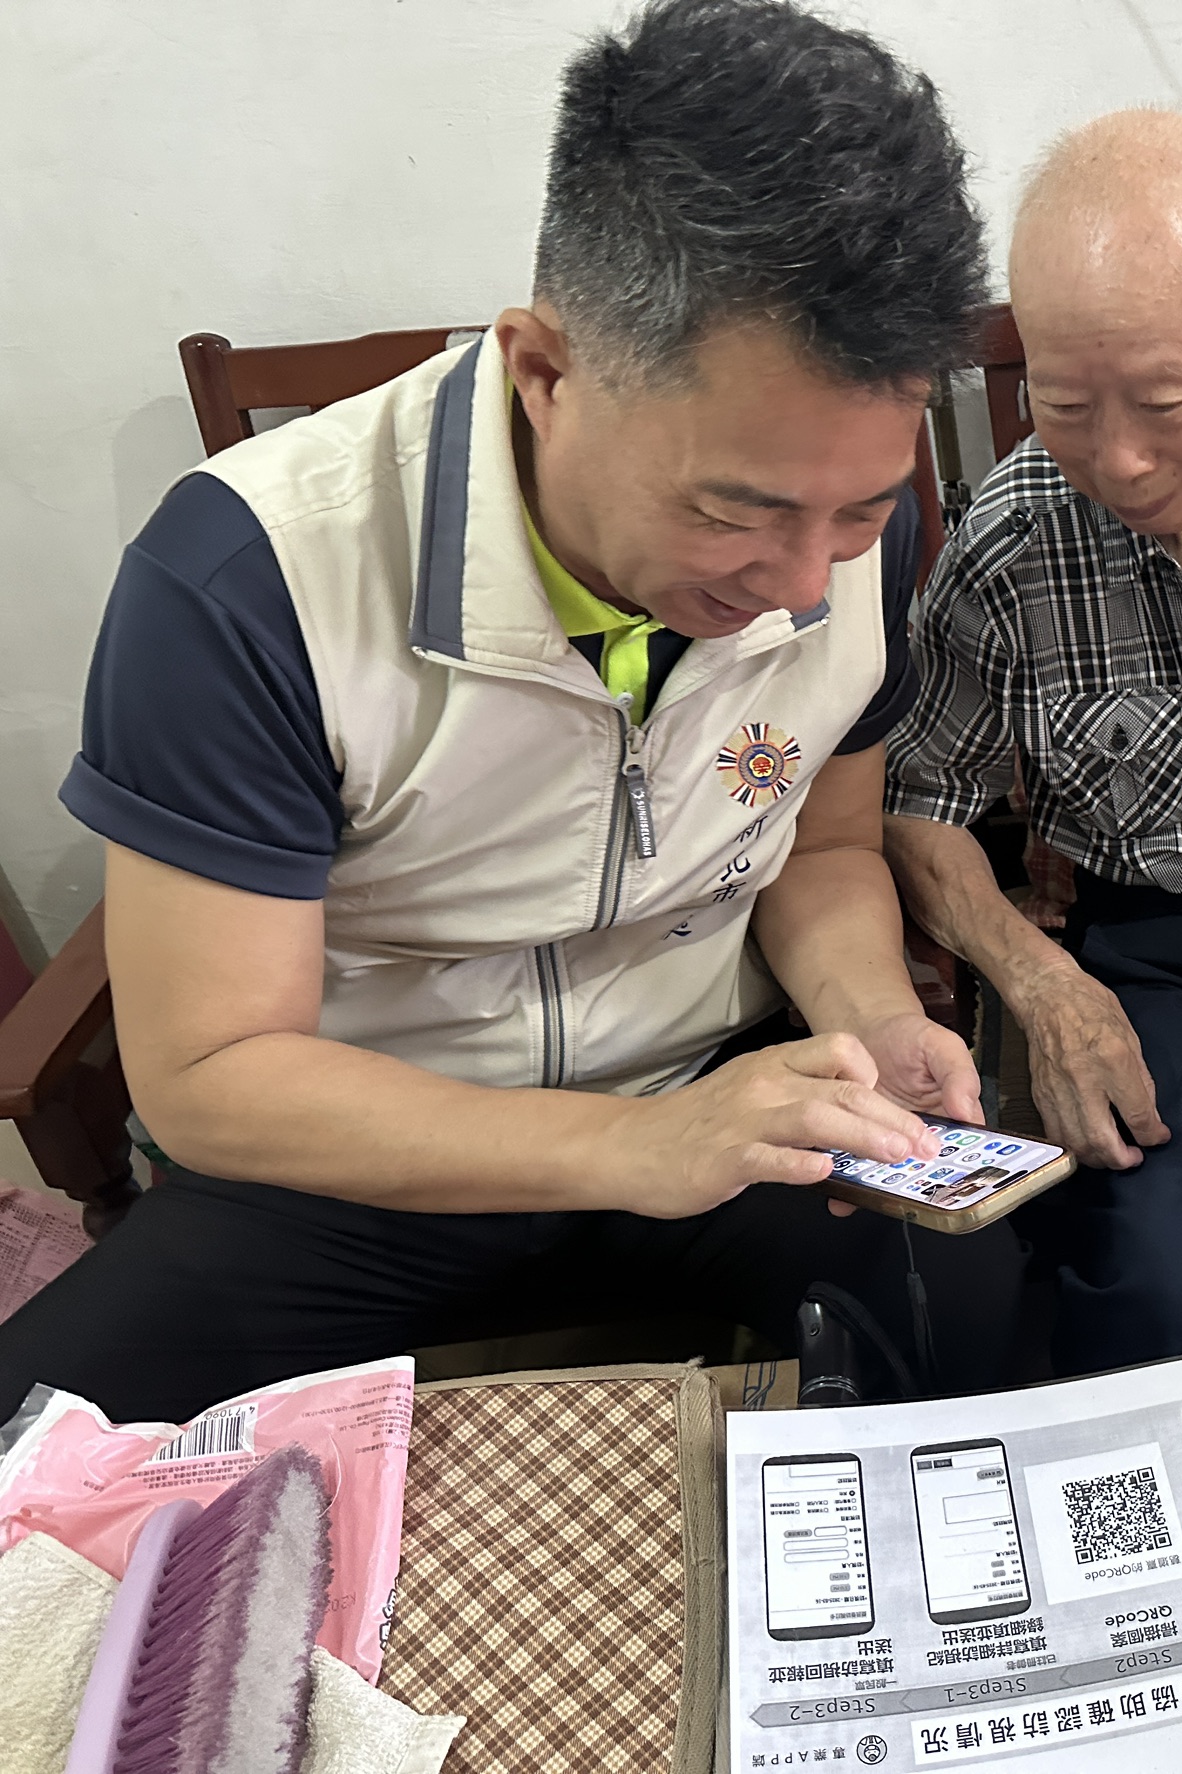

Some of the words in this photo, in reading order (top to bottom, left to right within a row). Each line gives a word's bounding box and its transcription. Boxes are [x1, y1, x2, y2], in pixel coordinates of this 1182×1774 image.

[1084, 1561, 1143, 1582] 的QRCode
[1104, 1605, 1173, 1628] QRCode
[941, 1616, 1045, 1646] 錄細項並送出
[1110, 1619, 1178, 1648] 掃描個案
[857, 1638, 893, 1657] 送出
[926, 1635, 1048, 1667] 填寫詳細訪視紀
[767, 1657, 895, 1684] 填寫訪視回報並
[1114, 1648, 1173, 1674] Step2
[854, 1678, 897, 1691] 一般民眾
[943, 1676, 1027, 1703] Step3-1
[788, 1697, 876, 1722] Step3-2
[751, 1747, 846, 1768] 專業APP端
